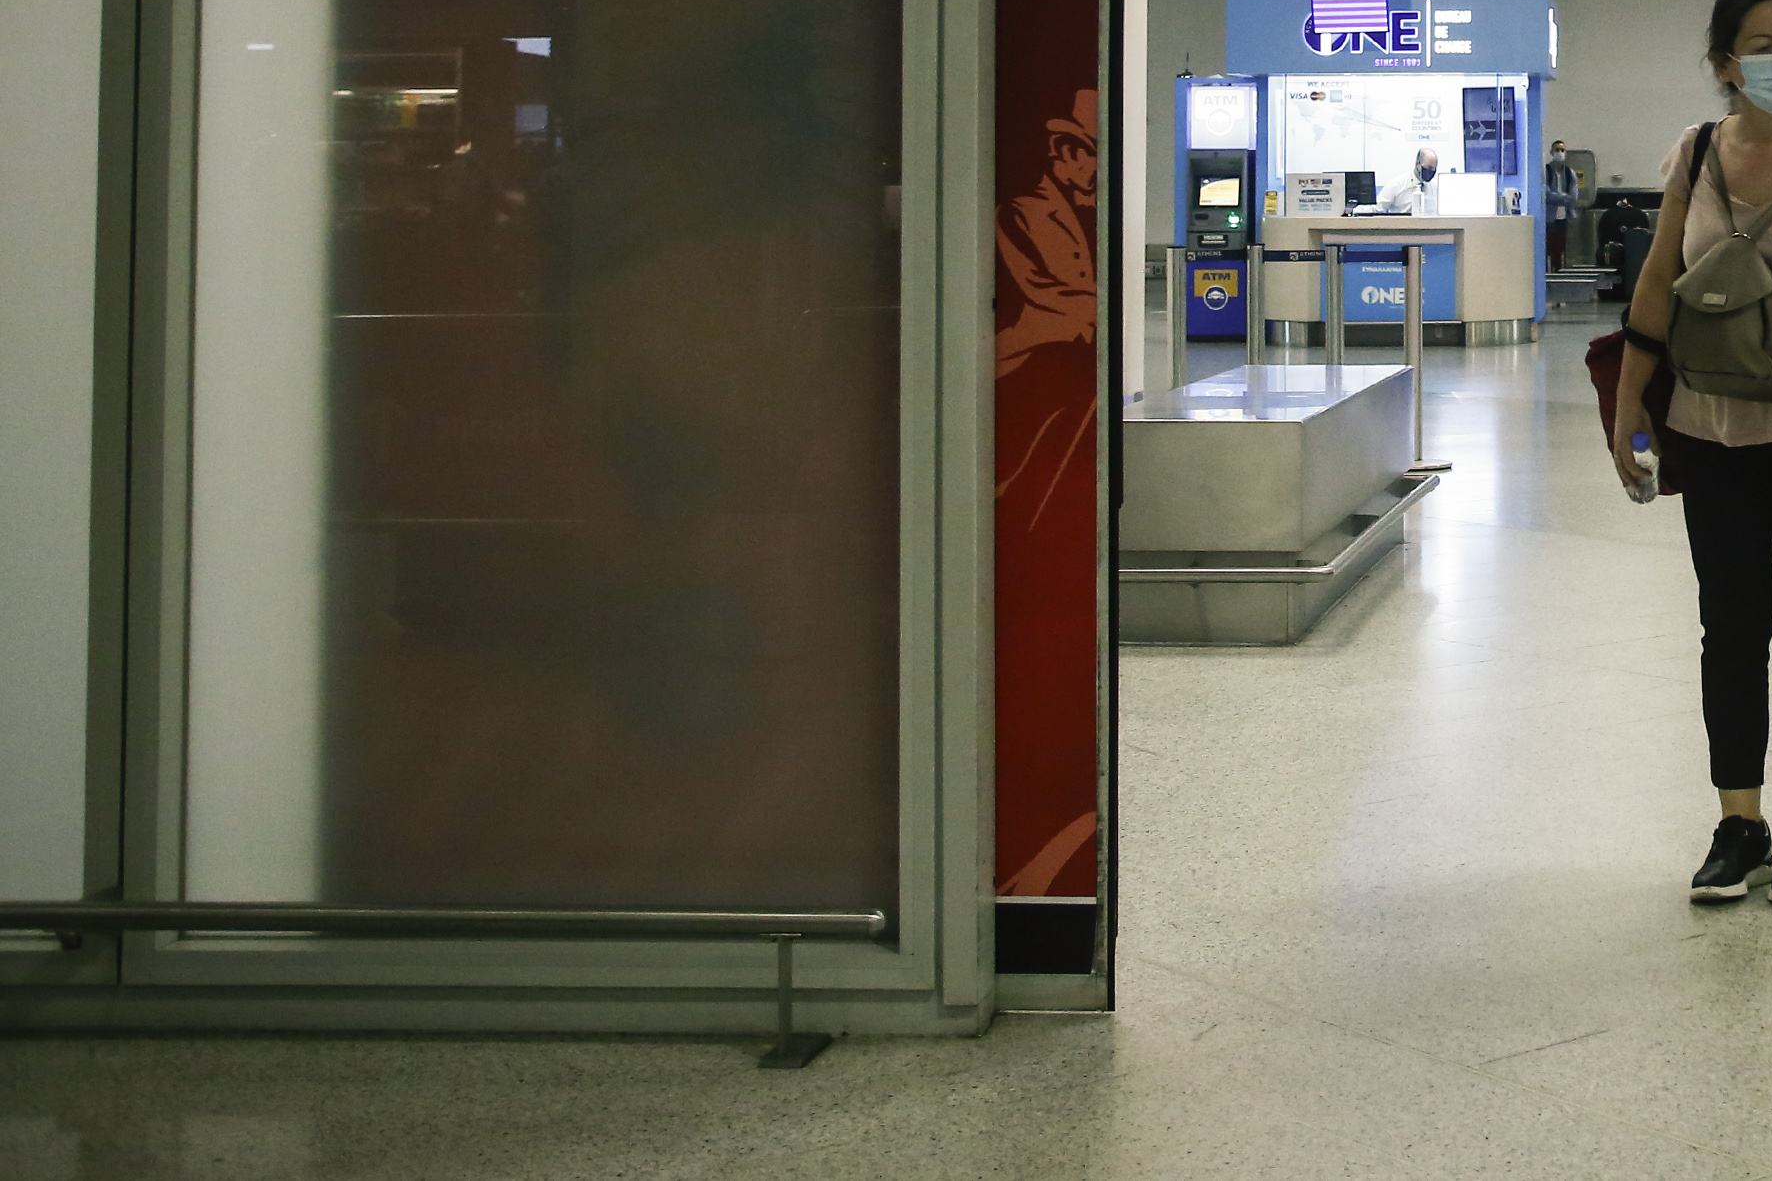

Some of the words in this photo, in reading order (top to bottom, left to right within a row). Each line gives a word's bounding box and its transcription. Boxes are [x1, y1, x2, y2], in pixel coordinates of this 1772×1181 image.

[1374, 58, 1399, 67] SINCE
[1203, 95, 1238, 106] ATM
[1289, 92, 1308, 100] VISA
[1412, 100, 1442, 120] 50
[1202, 272, 1231, 281] ATM
